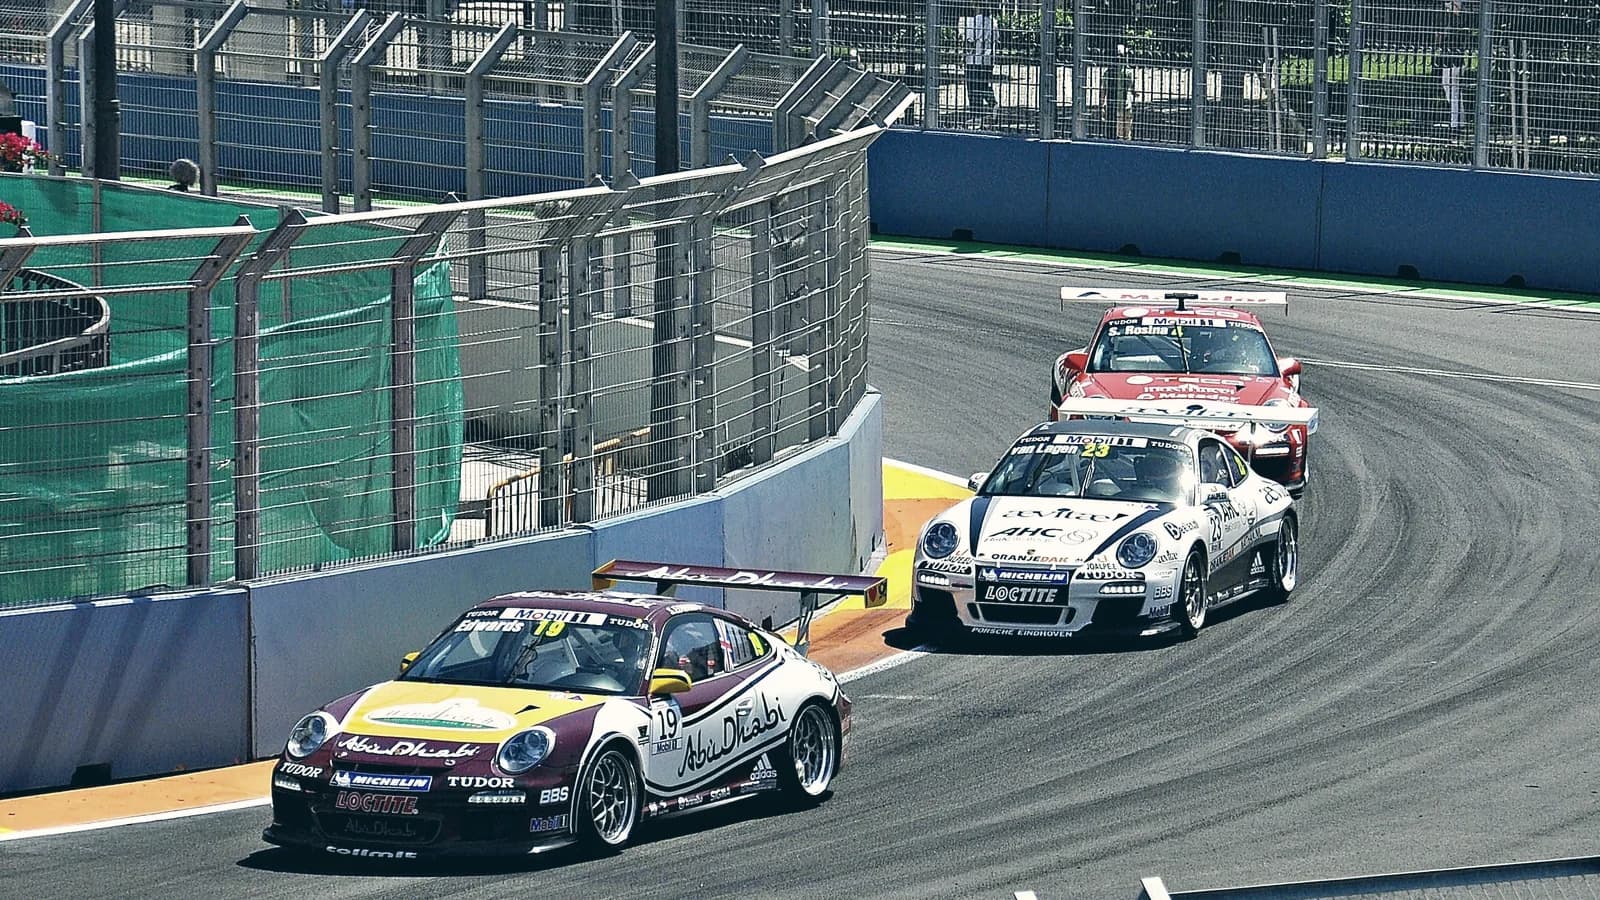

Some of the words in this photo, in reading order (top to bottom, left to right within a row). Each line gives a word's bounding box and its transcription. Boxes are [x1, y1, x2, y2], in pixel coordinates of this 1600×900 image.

[1153, 318, 1197, 326] Mobil
[1108, 327, 1121, 337] S.
[1124, 325, 1169, 336] Rosina
[1066, 435, 1113, 445] Mobil
[1011, 445, 1036, 456] van
[1036, 443, 1079, 455] Lagen
[1080, 443, 1110, 458] 23
[988, 527, 1064, 538] AHC
[1209, 515, 1222, 542] 23
[991, 553, 1070, 563] ORANJEDAK
[924, 561, 968, 574] TUDOR
[722, 571, 849, 591] Dhabi
[999, 571, 1066, 582] MICHELIN
[1083, 571, 1137, 580] TUDOR
[984, 585, 1059, 603] LOCTITE
[1154, 585, 1173, 600] BBS
[466, 609, 499, 618] TUDOR
[514, 609, 569, 622] Mobil
[454, 618, 525, 634] Edwards
[531, 619, 566, 638] 19
[608, 617, 650, 631] TUDOR
[970, 627, 1014, 637] PORSCHE
[1017, 629, 1073, 638] EINDHOVEN
[657, 708, 678, 741] 19
[678, 729, 721, 778] Abu
[722, 691, 788, 751] Dhabi
[337, 735, 389, 755] Abu
[389, 741, 481, 759] Dhabi
[656, 741, 672, 753] Mobil
[279, 762, 323, 778] TUDOR
[750, 769, 778, 781] adidas
[352, 775, 428, 788] MICHELIN
[447, 776, 515, 788] TUDOR
[539, 786, 570, 805] BBS
[335, 790, 418, 815] LOCTITE
[529, 817, 561, 832] Mobil
